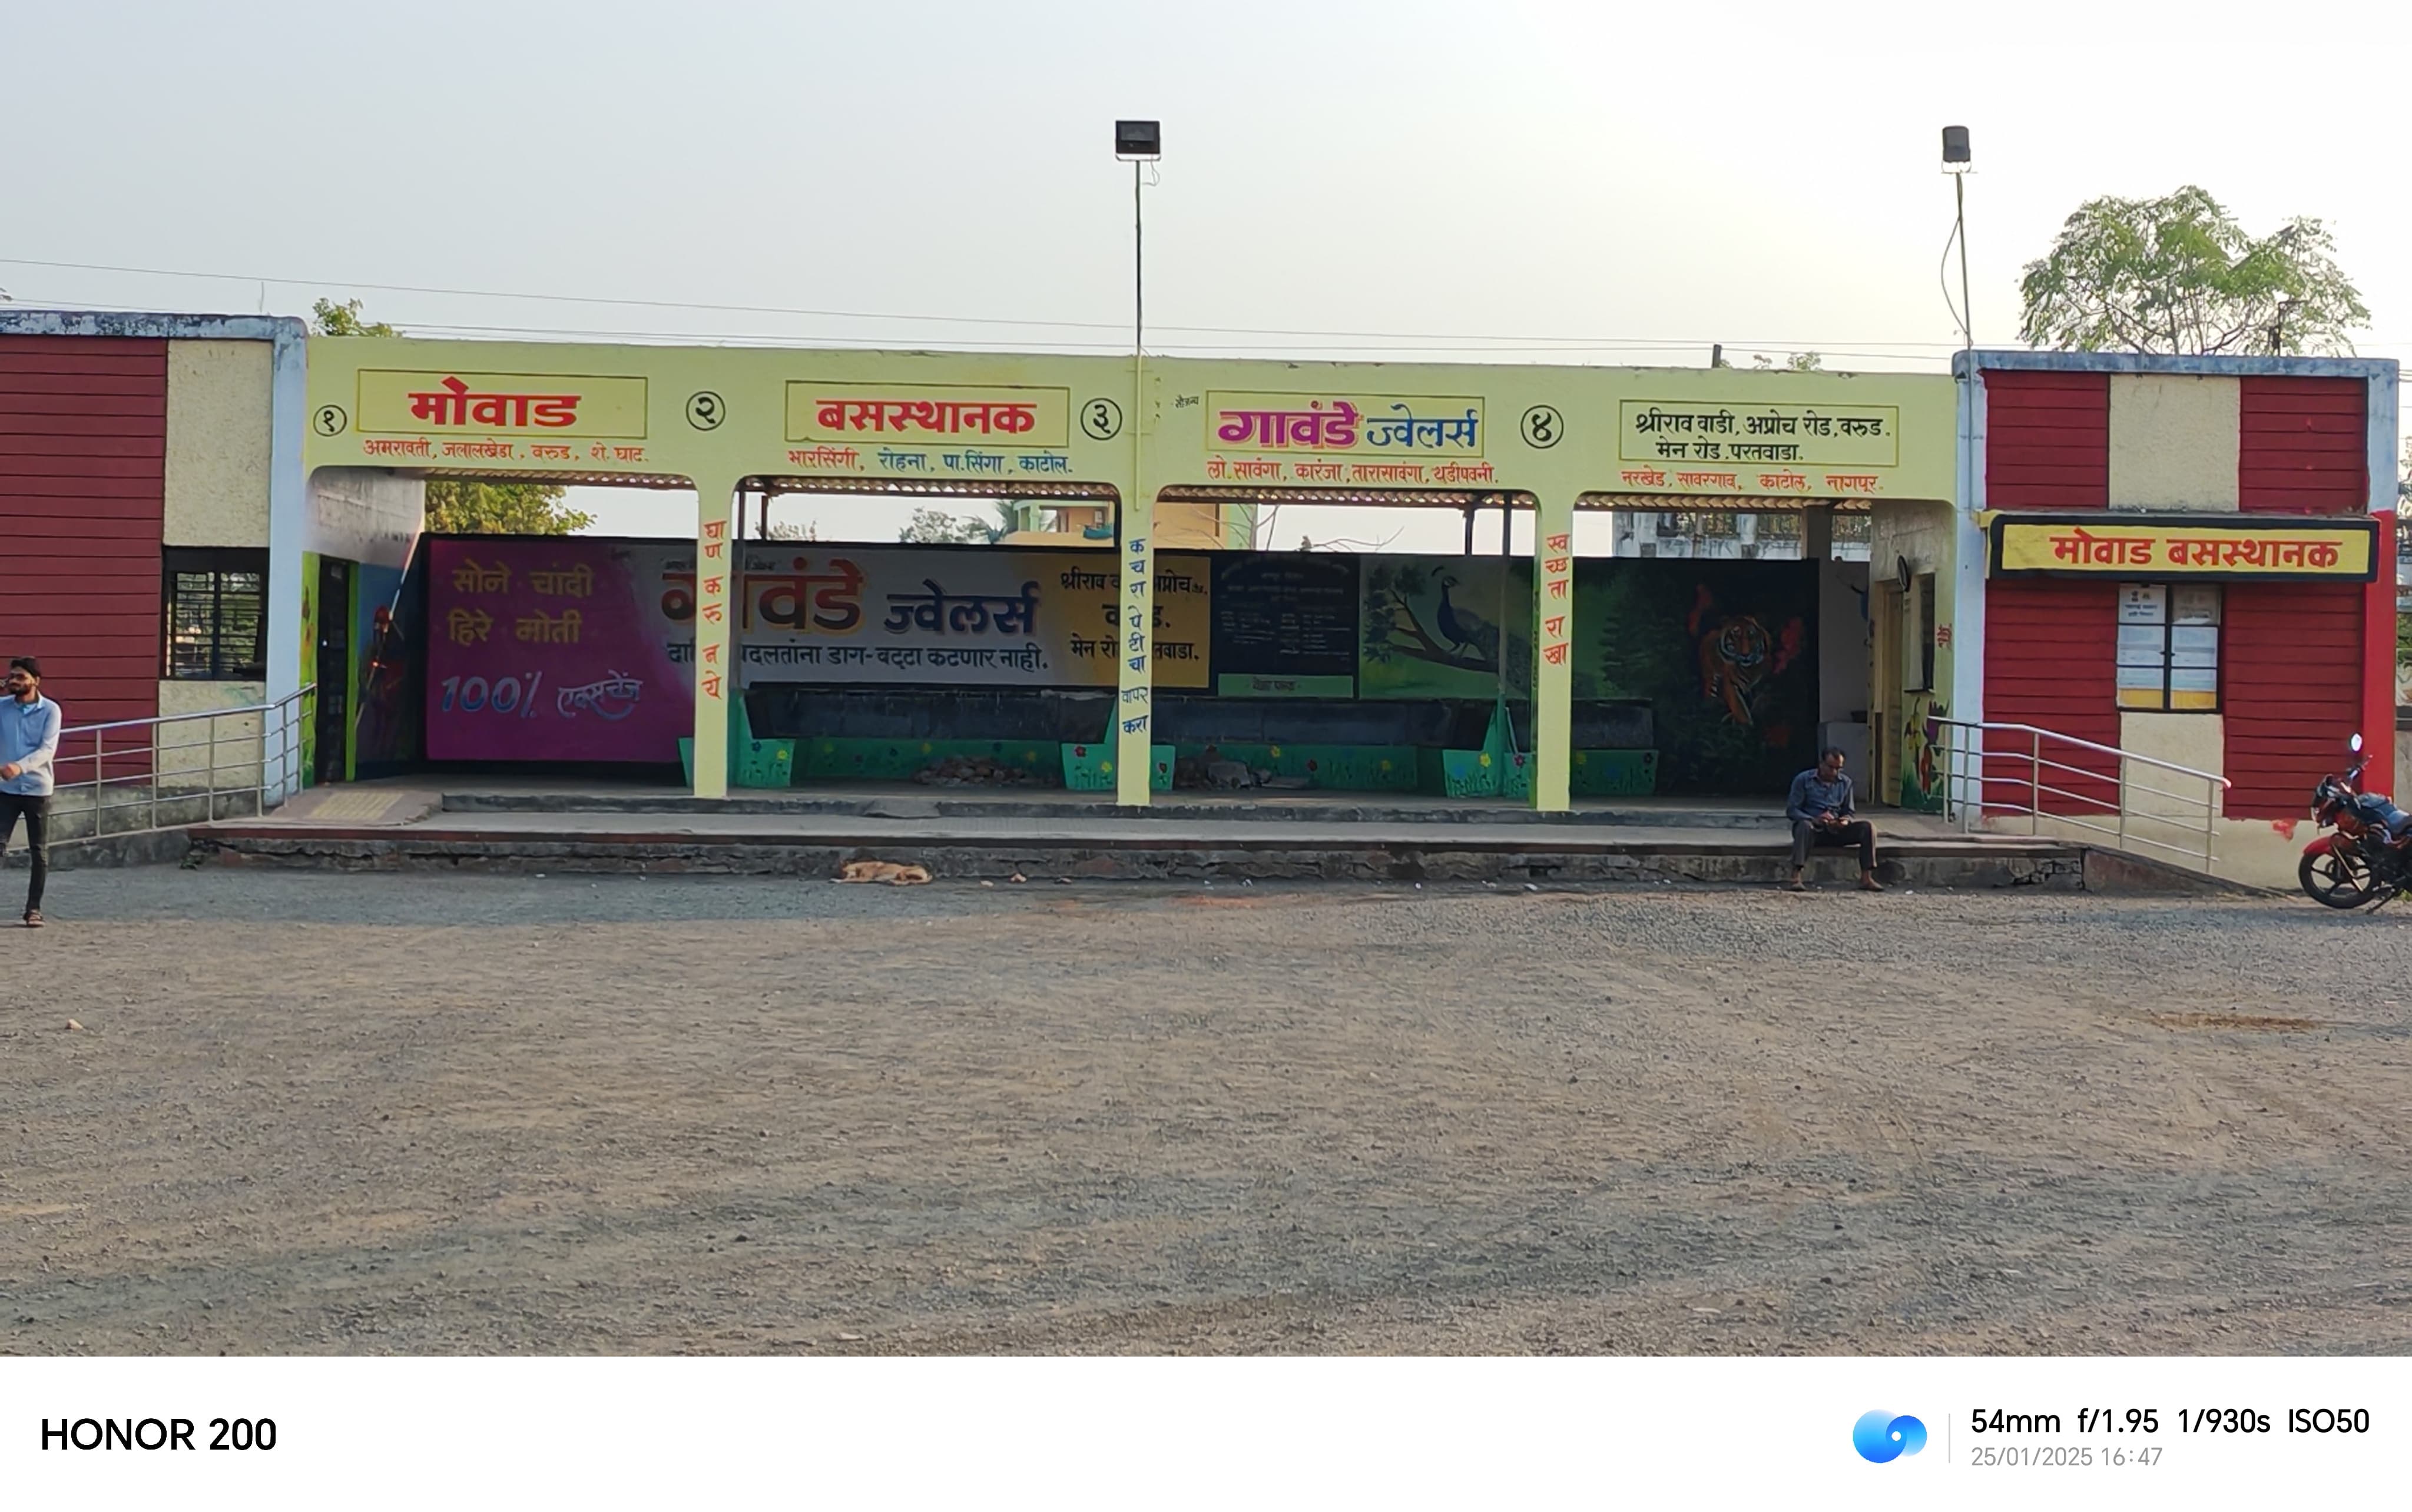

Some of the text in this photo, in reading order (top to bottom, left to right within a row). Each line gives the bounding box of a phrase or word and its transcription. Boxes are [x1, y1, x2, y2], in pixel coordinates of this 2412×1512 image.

[408, 376, 581, 427] मोवाड
[816, 399, 1036, 434] बसस्थानक
[1218, 401, 1478, 449] गावंडे ज्वेलर्स
[1636, 407, 1694, 436] श्रीराव
[1698, 410, 1741, 437] वाडी,
[1747, 409, 1798, 437] अप्रोच
[1655, 435, 1688, 459] मेन
[2050, 526, 2343, 569] मोवाड बसस्थानक
[452, 557, 595, 597] सोने चांदी
[1061, 566, 1108, 591] श्रीराव
[1153, 569, 1193, 593] प्रोच
[884, 579, 1041, 635] ज्वेलर्स
[447, 606, 582, 646] हिरे मोती
[928, 646, 999, 670] कटणार
[1000, 642, 1049, 672] नाही.
[1071, 632, 1097, 659] मेन
